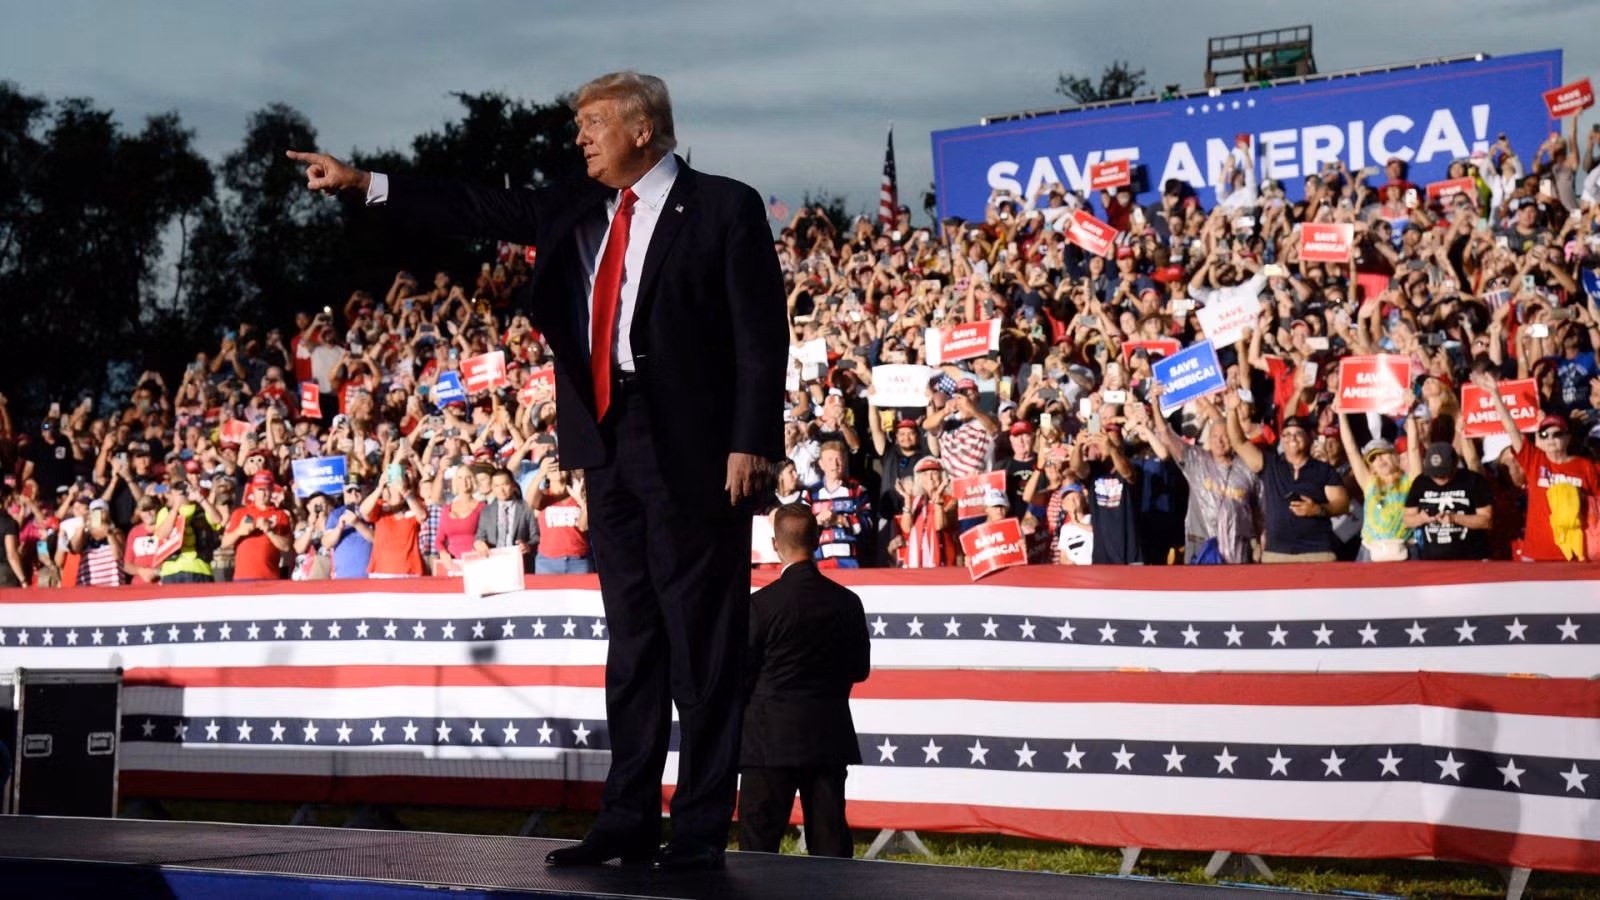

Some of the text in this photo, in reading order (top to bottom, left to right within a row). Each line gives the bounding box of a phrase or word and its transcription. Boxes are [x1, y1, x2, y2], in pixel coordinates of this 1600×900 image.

[1158, 104, 1491, 192] AMERICA!
[1313, 231, 1338, 242] SAVE
[1303, 242, 1348, 253] AMERICA!
[1218, 306, 1245, 321] SAVE
[952, 328, 977, 340] SAVE
[943, 336, 988, 353] AMERICA!
[1168, 356, 1199, 378] SAVE
[1466, 406, 1536, 425] AMECA!
[974, 532, 1005, 550] SAVE
[972, 543, 1021, 568] AMERICA!
